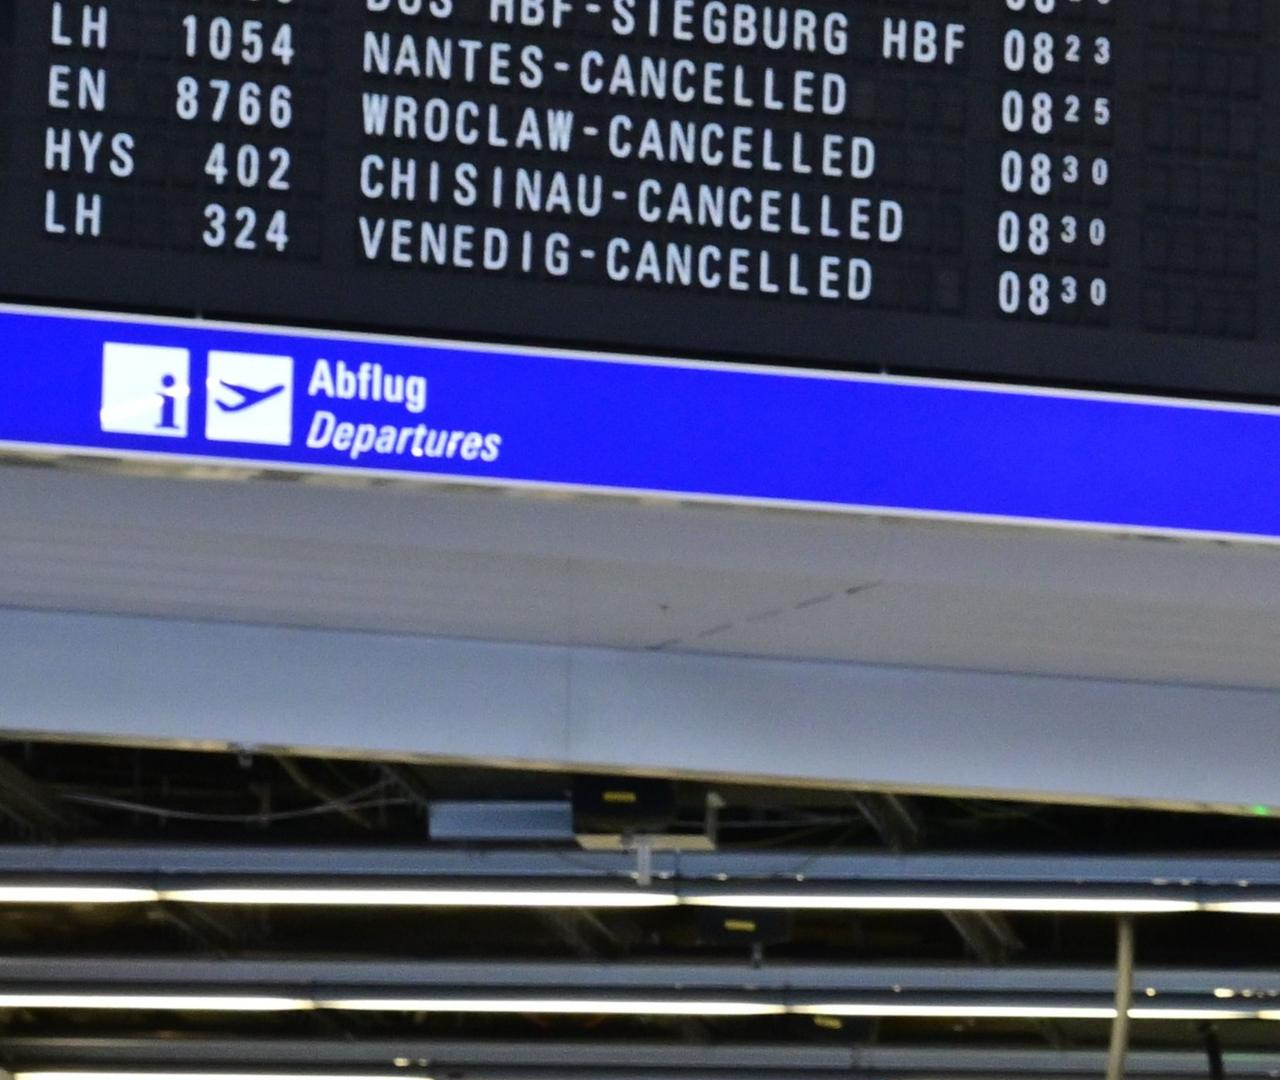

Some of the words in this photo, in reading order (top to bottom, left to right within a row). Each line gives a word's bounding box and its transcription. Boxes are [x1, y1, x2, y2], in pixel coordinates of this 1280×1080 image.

[50, 1, 108, 50] LH
[181, 13, 295, 66] 1054
[362, 29, 847, 116] NANTES-CANCELLED
[881, 16, 966, 66] HBF
[47, 63, 107, 112] EN
[175, 75, 293, 130] 8766
[361, 91, 876, 180] WROCLAW-CANCELLED
[44, 126, 136, 178] HYS
[203, 141, 291, 191] 402
[359, 153, 904, 243] CHISINAU-CANCELLED
[44, 188, 102, 238] LH
[201, 202, 290, 253] 324
[358, 215, 873, 301] VENEDIG-CANCELLED
[305, 410, 503, 463] Departures
[306, 357, 428, 415] Abflug
